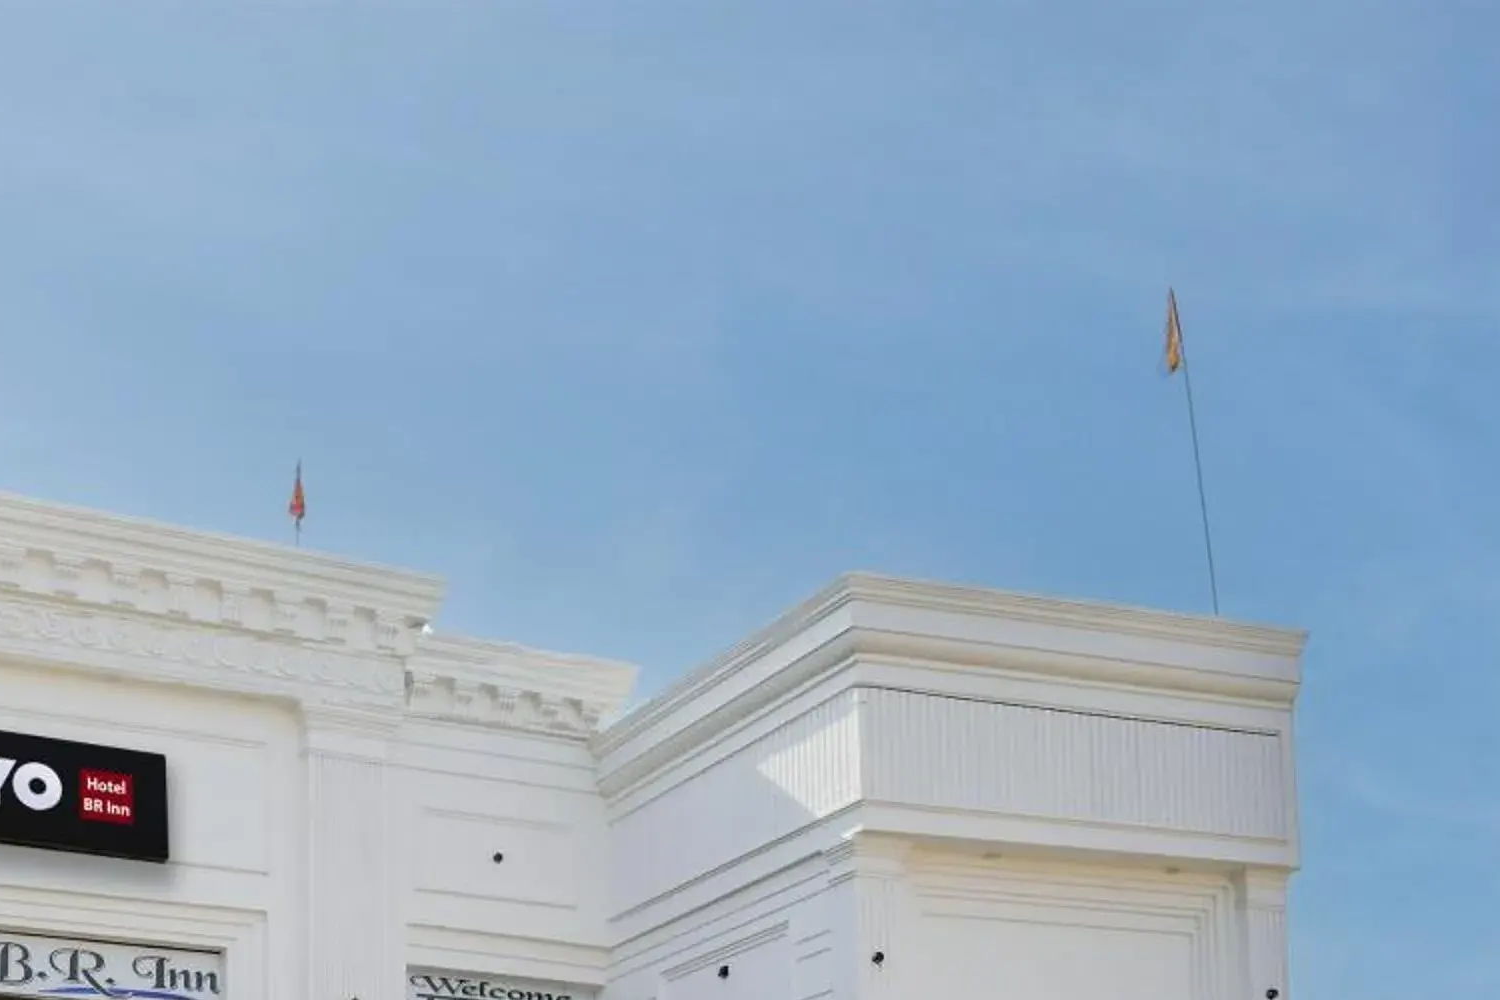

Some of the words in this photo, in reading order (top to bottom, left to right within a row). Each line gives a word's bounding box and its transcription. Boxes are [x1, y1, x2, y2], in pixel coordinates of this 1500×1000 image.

[86, 776, 126, 795] Hotel
[83, 798, 104, 813] BR
[106, 801, 131, 817] Inn
[132, 954, 221, 995] Inn
